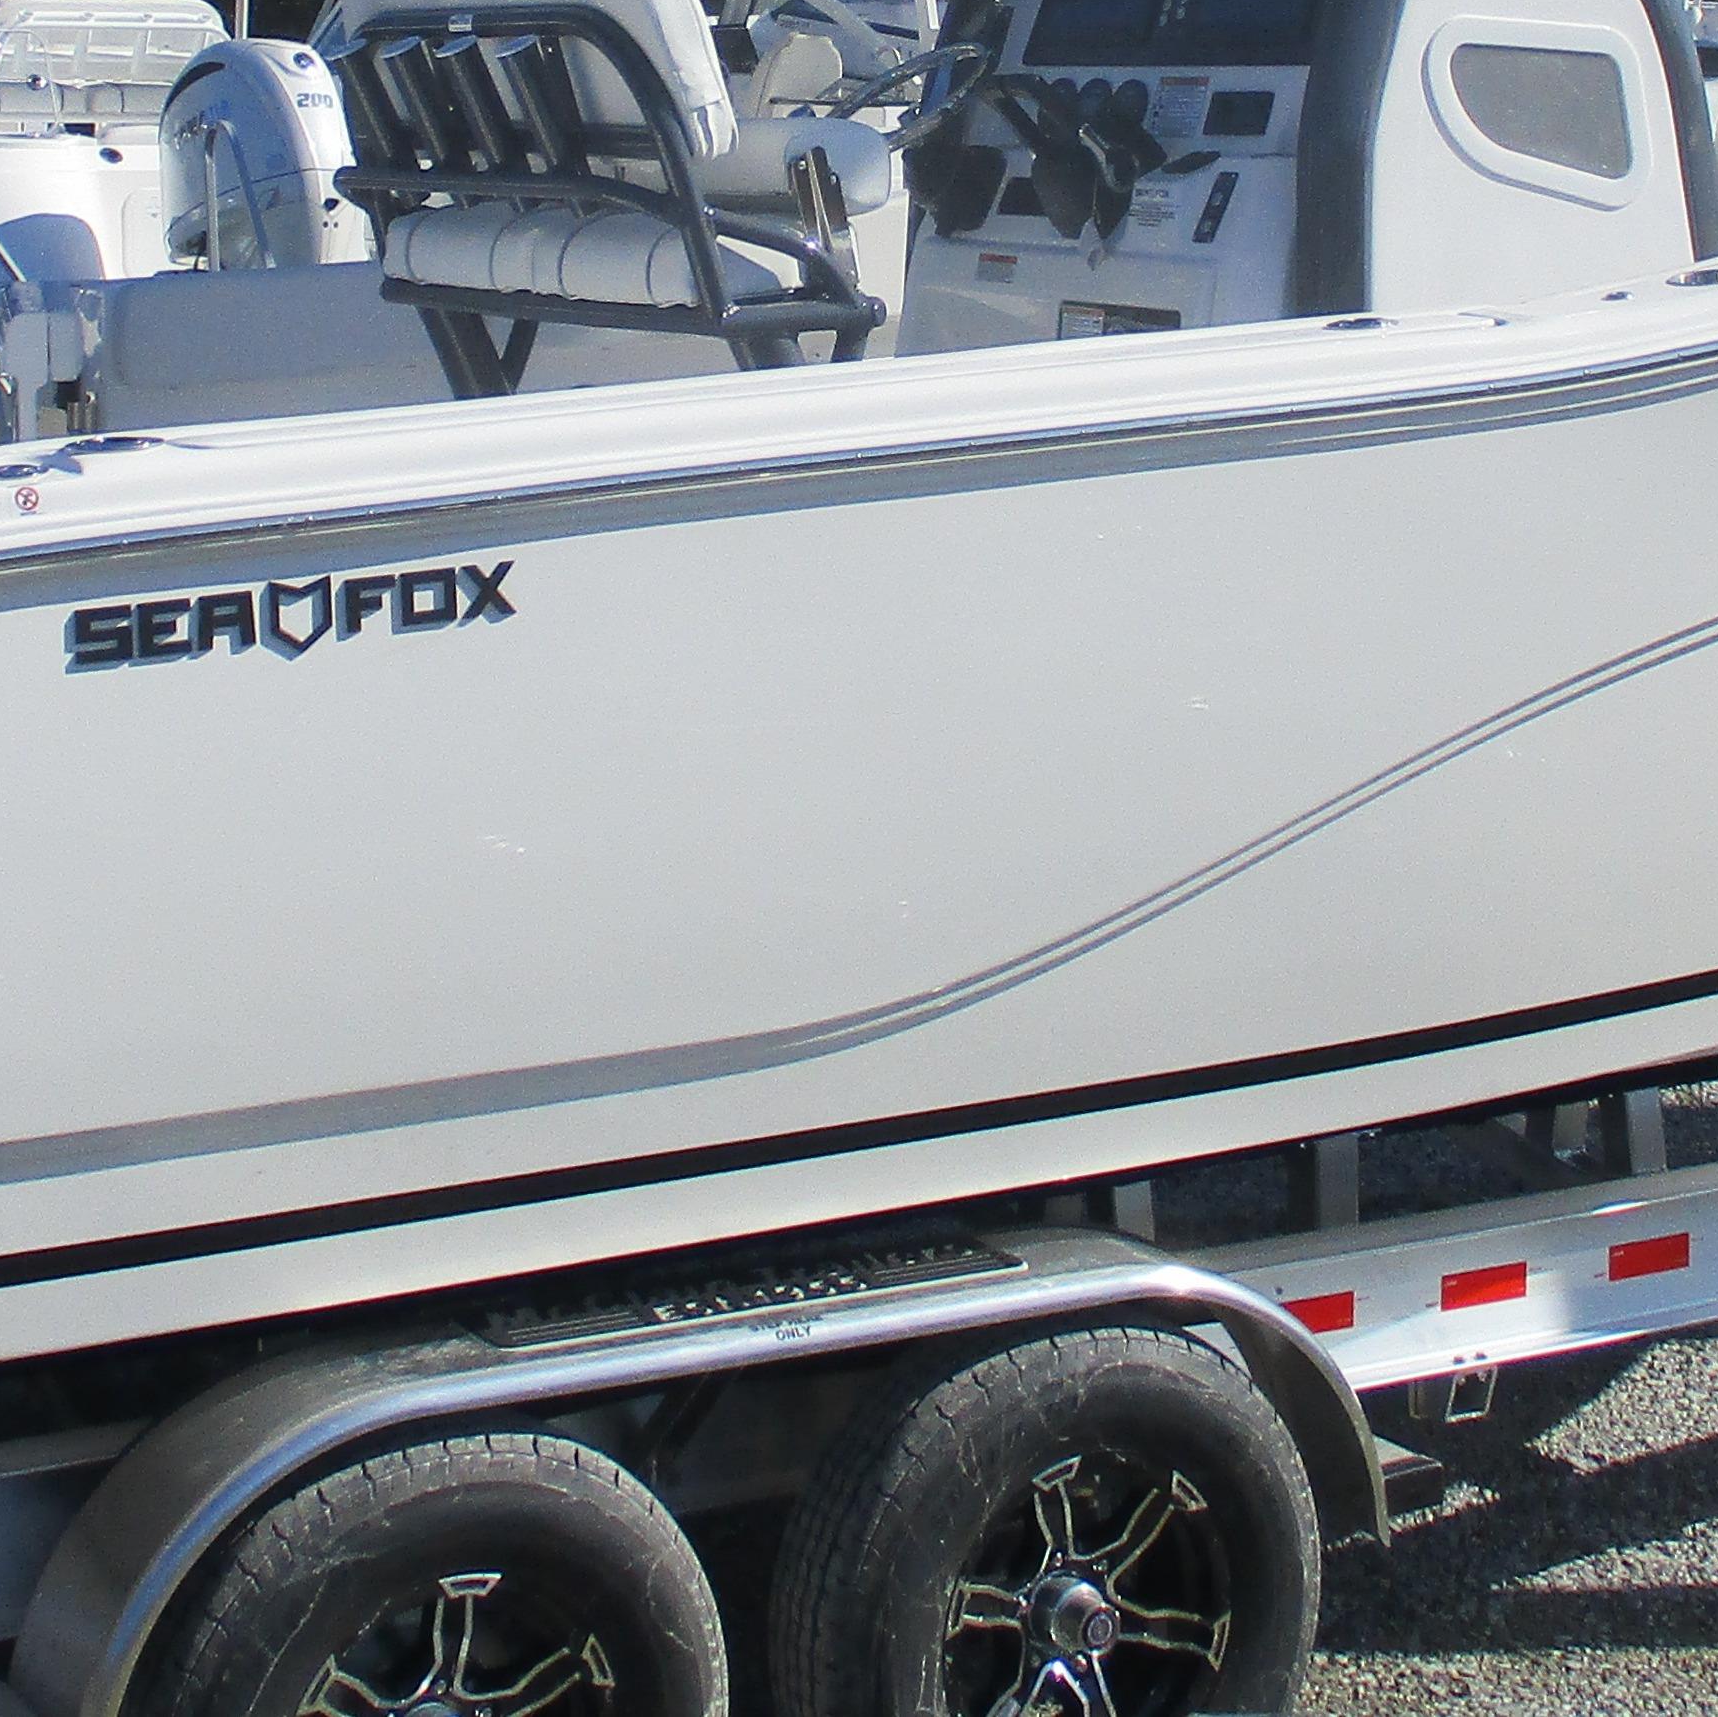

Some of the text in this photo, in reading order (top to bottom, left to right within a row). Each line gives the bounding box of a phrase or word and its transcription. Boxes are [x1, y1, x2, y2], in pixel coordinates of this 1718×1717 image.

[296, 93, 334, 109] 200
[69, 561, 518, 669] SEA FOX
[775, 1325, 812, 1342] ONLY
